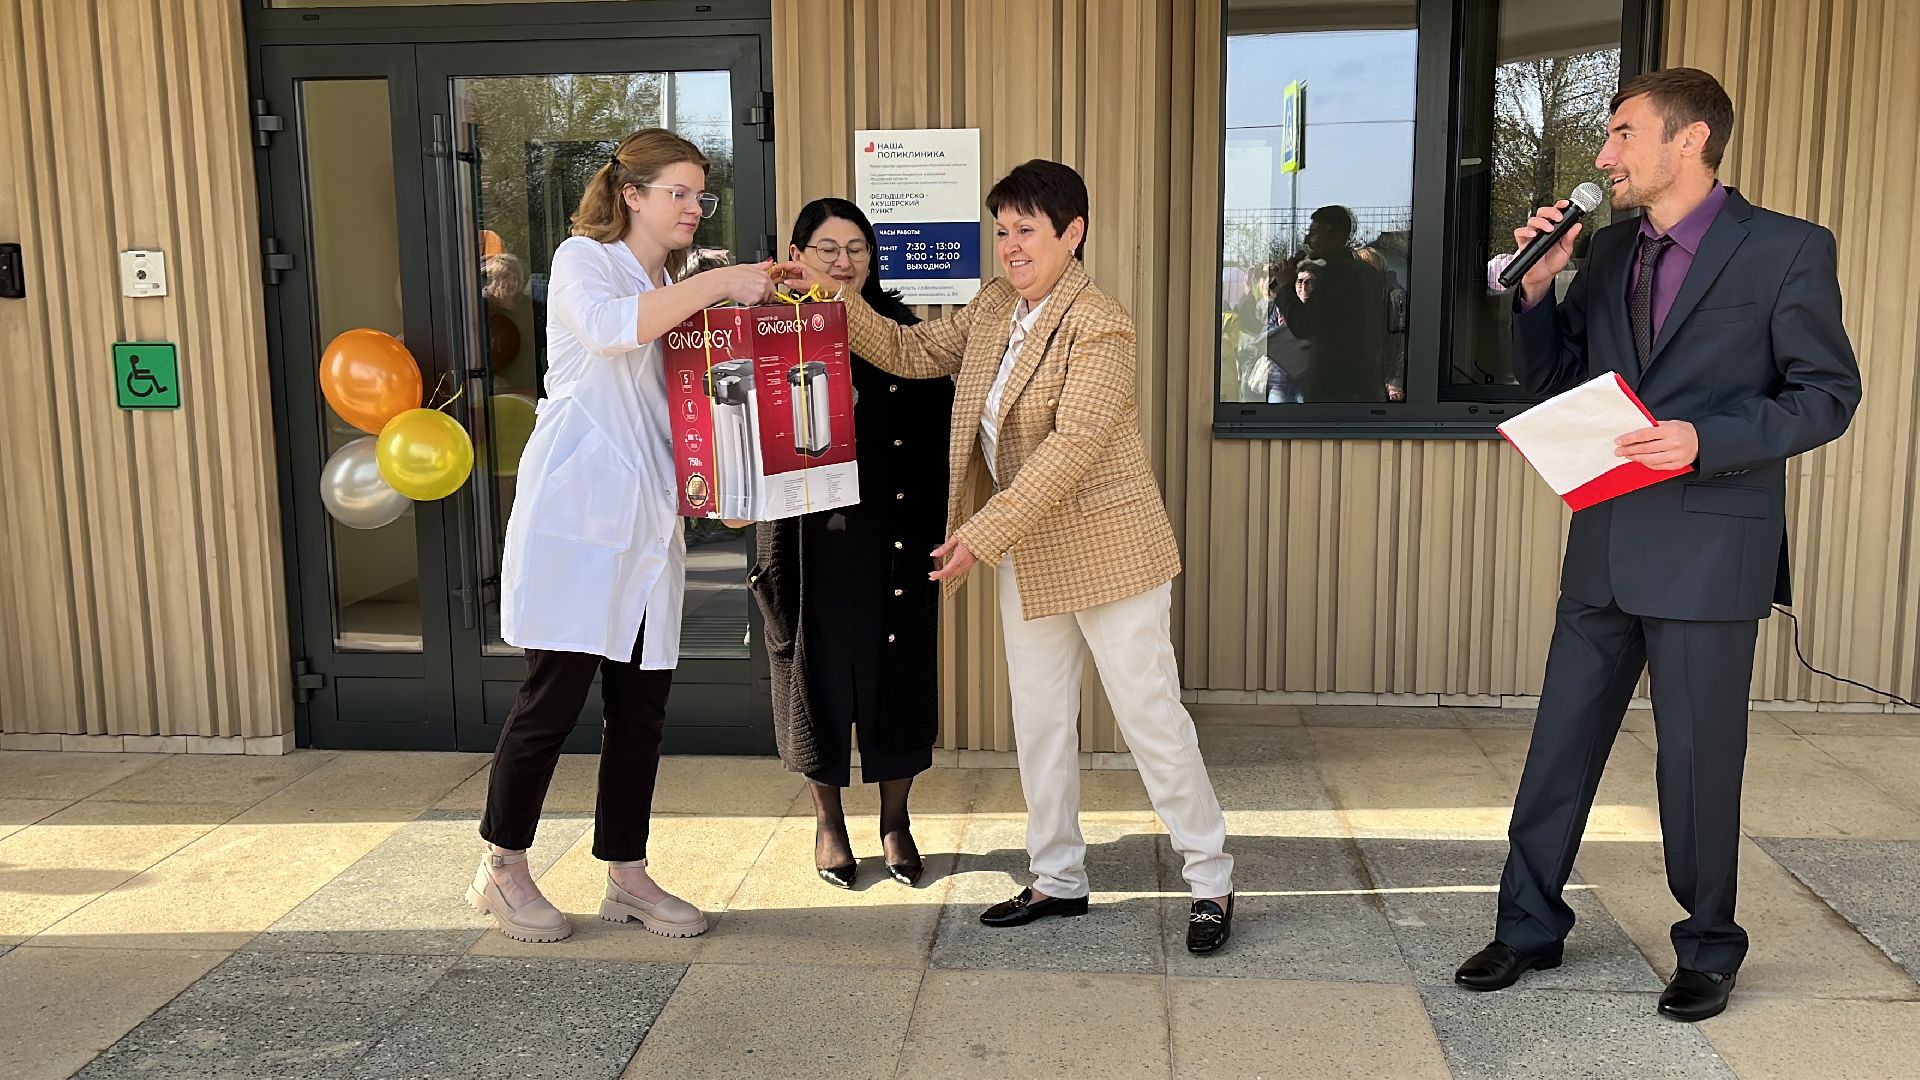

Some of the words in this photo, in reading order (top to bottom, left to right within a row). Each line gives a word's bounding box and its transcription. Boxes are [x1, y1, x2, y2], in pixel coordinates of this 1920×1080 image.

[906, 242, 926, 250] 7:30
[935, 242, 960, 250] 13:00
[905, 253, 927, 261] 9:00
[935, 252, 960, 260] 12:00
[906, 262, 951, 270] ВЫХОДНОЙ
